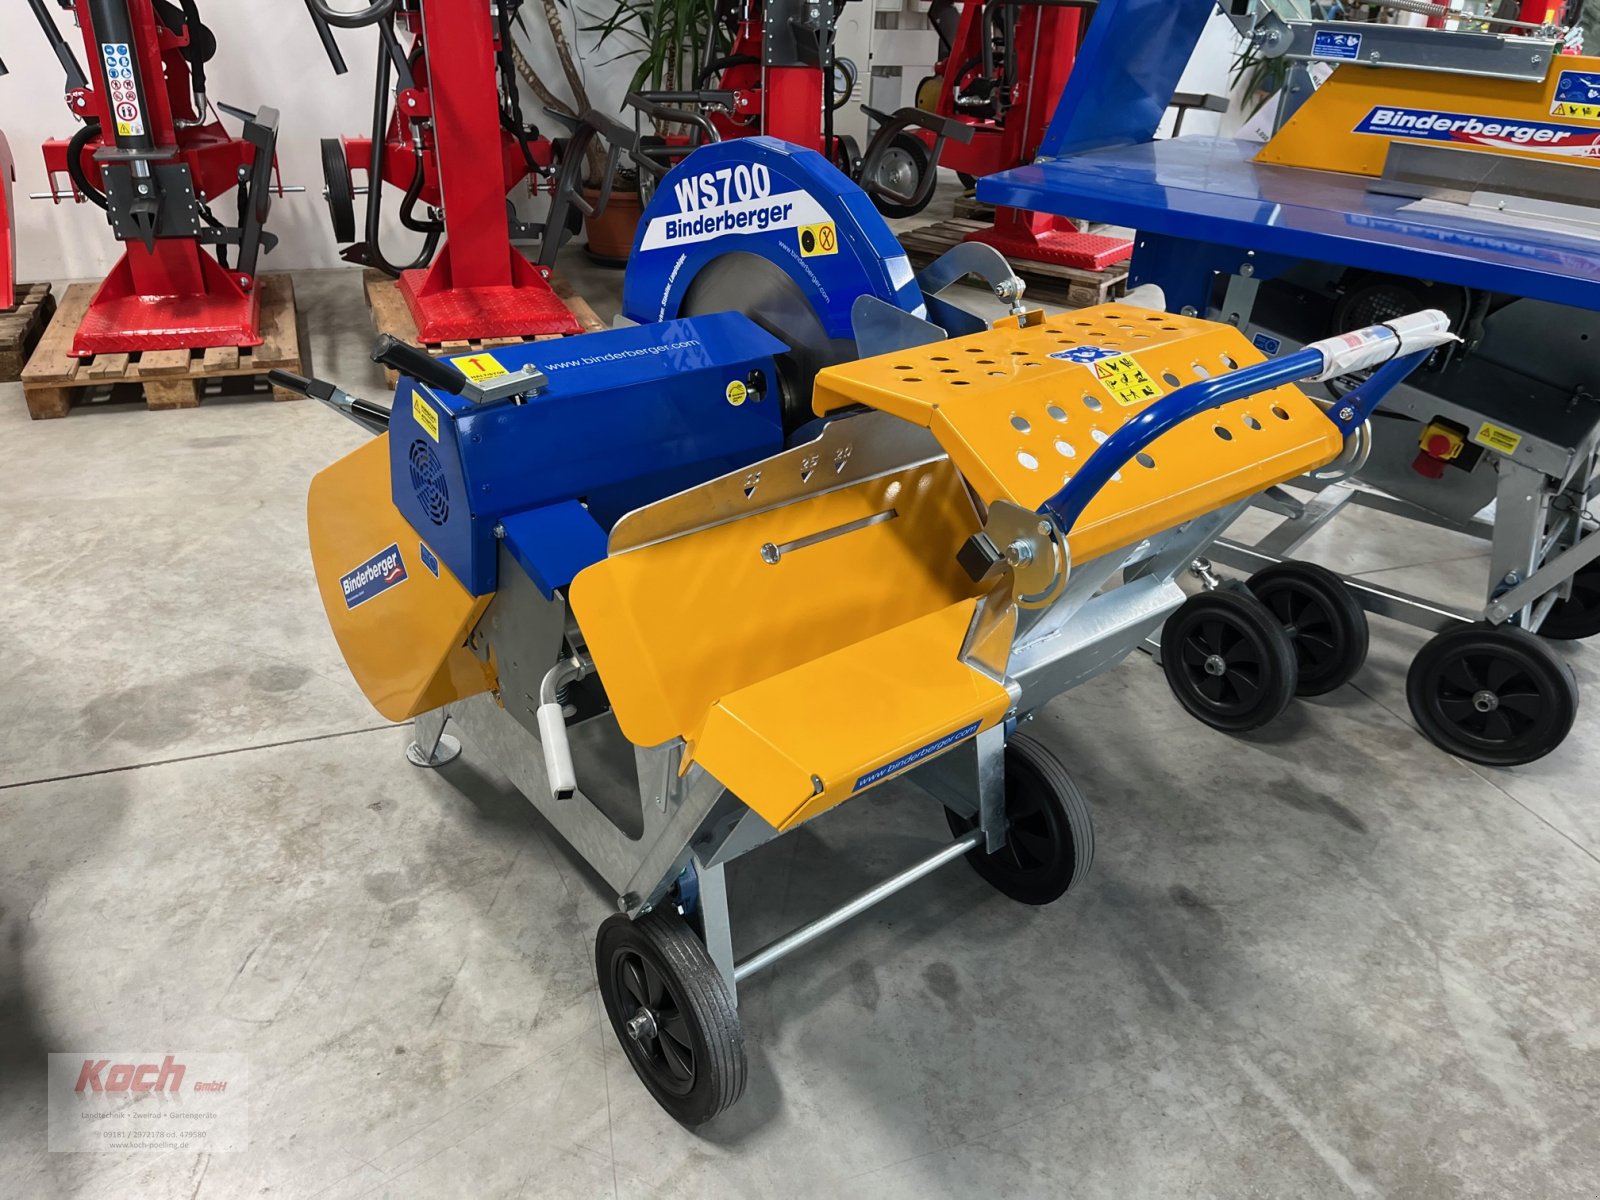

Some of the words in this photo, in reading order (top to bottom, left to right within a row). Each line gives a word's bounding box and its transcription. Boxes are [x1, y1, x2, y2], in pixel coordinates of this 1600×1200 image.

[1370, 109, 1572, 143] Binderberger
[674, 162, 771, 214] WS700
[666, 203, 793, 240] Binderberger
[778, 240, 830, 304] www.binderberger.com
[544, 339, 700, 371] www.binderberger.com
[343, 552, 397, 595] Binderberger
[859, 725, 977, 786] www.binderberger.com
